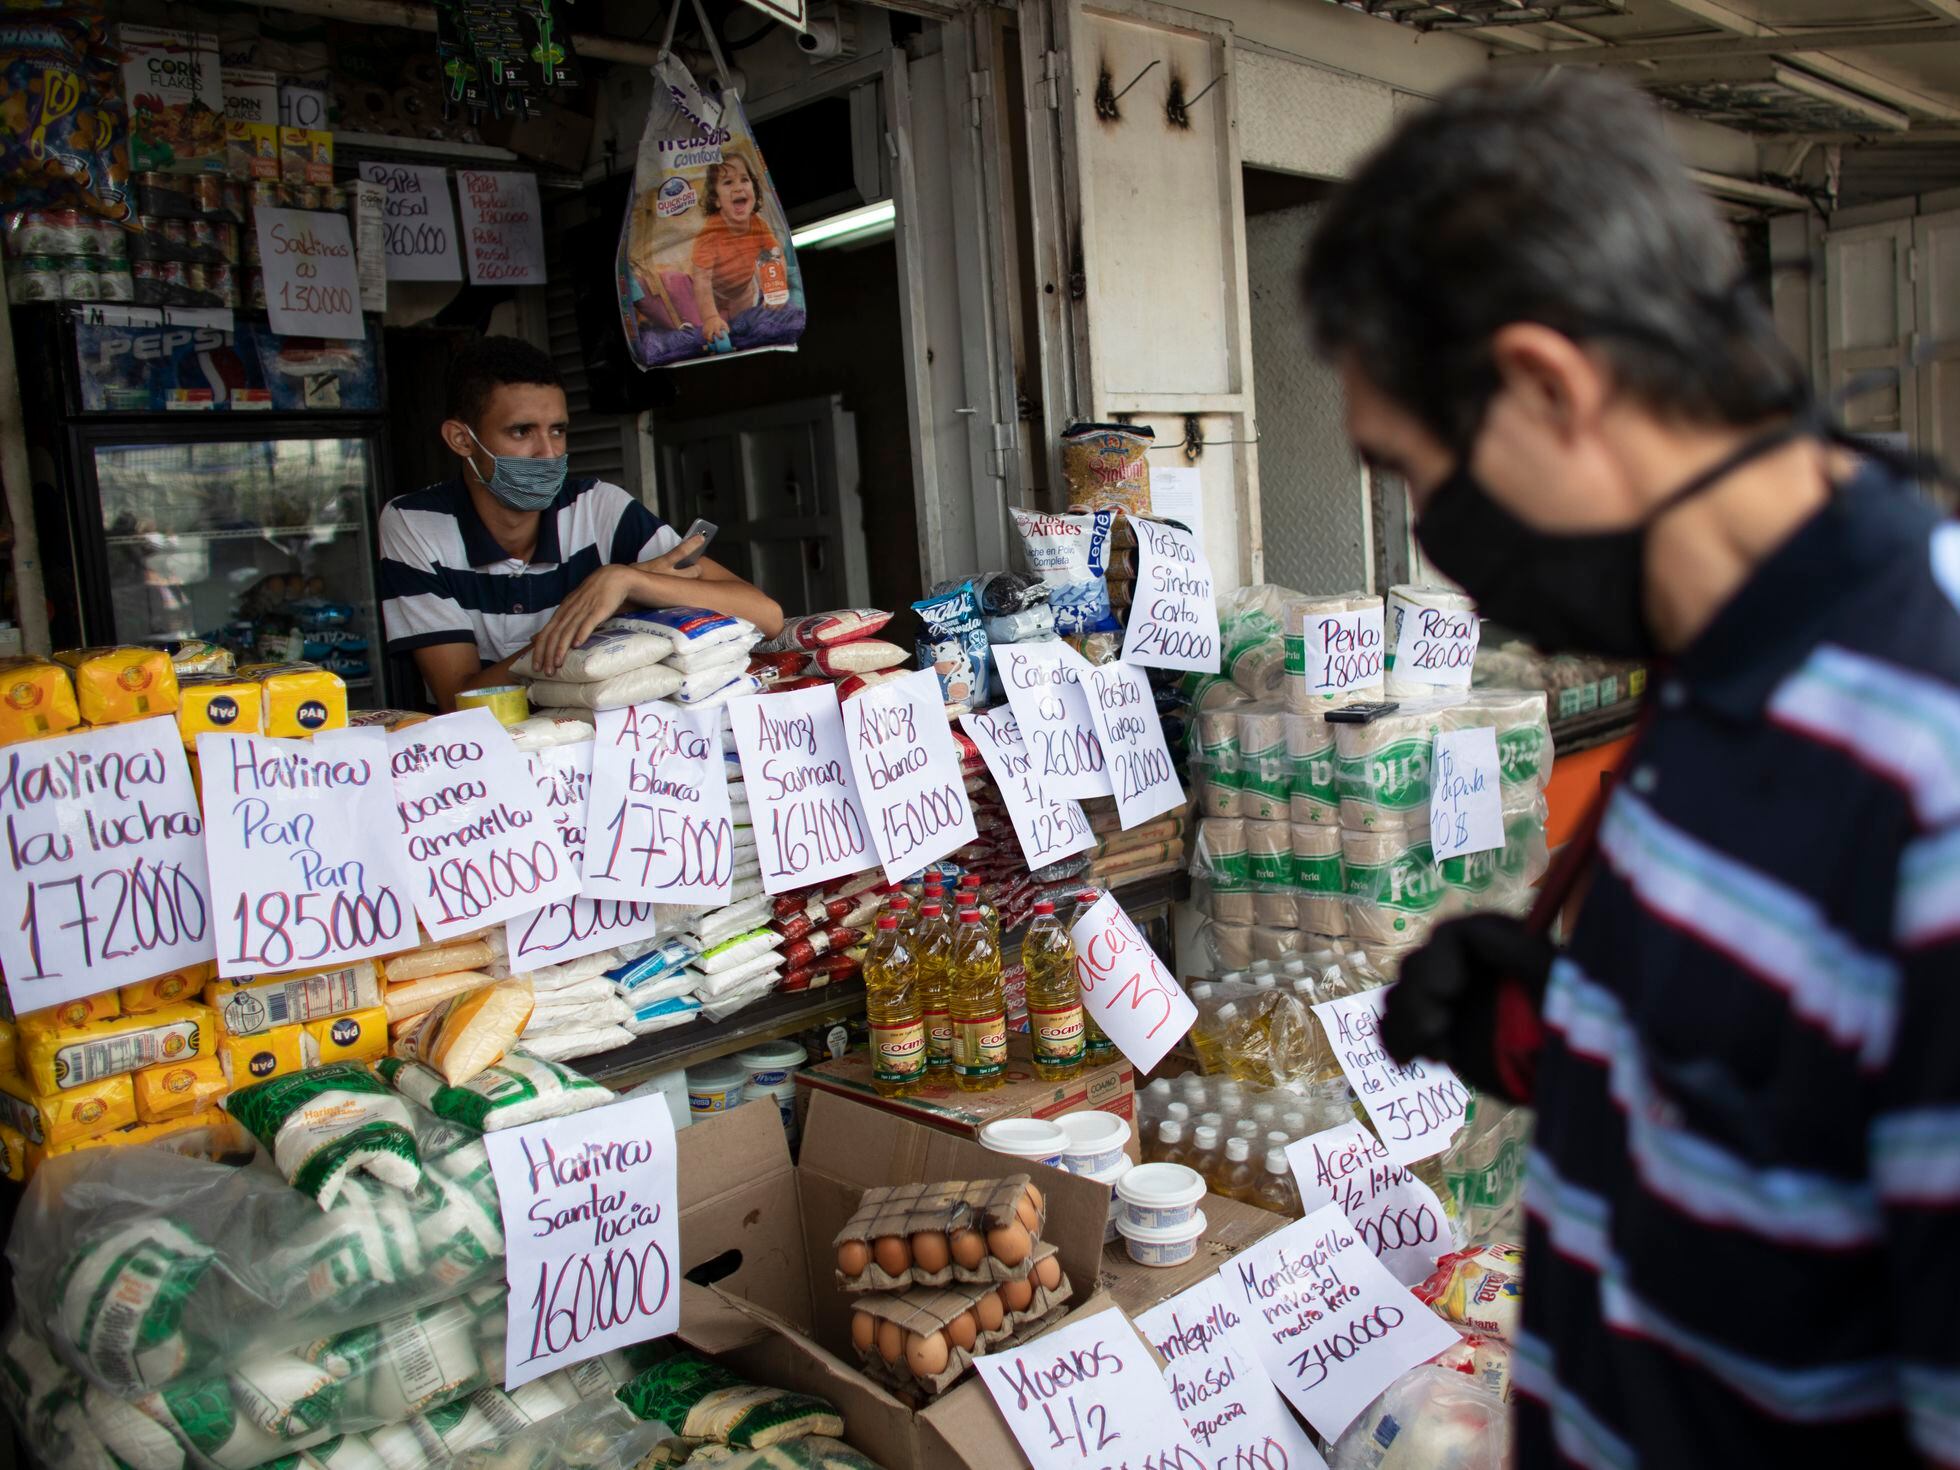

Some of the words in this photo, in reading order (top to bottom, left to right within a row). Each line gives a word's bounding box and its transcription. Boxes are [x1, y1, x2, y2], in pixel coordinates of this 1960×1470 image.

[148, 58, 201, 76] CORN
[150, 73, 203, 91] FLAKES
[101, 327, 235, 361] PEPSI
[1088, 456, 1144, 482] Sindoni
[1031, 519, 1082, 537] Andes
[1088, 514, 1109, 568] Leche
[1138, 520, 1195, 563] Pasta
[1151, 565, 1210, 600] Sindoni
[1317, 616, 1379, 655] Perla
[209, 705, 236, 718] PAN
[299, 708, 326, 720] PAN
[1091, 671, 1141, 711] Pasta
[758, 703, 817, 756] Arroz
[859, 699, 917, 751] Arroz
[1033, 725, 1106, 777] 260.00
[1103, 714, 1146, 745] larga
[230, 738, 372, 795] Harina
[391, 741, 484, 777] arina
[629, 758, 700, 802] blanca
[762, 759, 848, 801] Saman
[866, 746, 928, 791] blanco
[6, 814, 74, 872] la
[85, 800, 200, 852] lucha
[232, 797, 316, 849] Pan
[408, 802, 533, 862] amarilla
[590, 794, 734, 890] 175.000
[882, 783, 964, 865] 150.000
[290, 849, 366, 892] Pan
[428, 840, 559, 926] 180.000
[20, 856, 206, 981] 172.000
[227, 885, 402, 967] 185.000
[334, 1025, 359, 1040] PAN
[1346, 1040, 1387, 1069] natu
[251, 1058, 274, 1072] PAN
[1362, 1070, 1381, 1095] de
[1386, 1062, 1426, 1088] litro
[1376, 1080, 1467, 1141] 350.000
[519, 1136, 653, 1195] Harina
[1313, 1133, 1390, 1187] Aceite
[528, 1183, 627, 1238] Santa
[1331, 1178, 1365, 1217] 1/2
[1369, 1165, 1414, 1199] litro
[594, 1202, 661, 1246] lucia
[1237, 1229, 1354, 1304] Mantequilla
[516, 1240, 670, 1367] 160.000
[1272, 1309, 1324, 1344] medio
[1323, 1285, 1360, 1312] kilo
[1287, 1306, 1404, 1392] 340.000
[998, 1341, 1124, 1412] Huevos
[1043, 1396, 1121, 1458] 1/2
